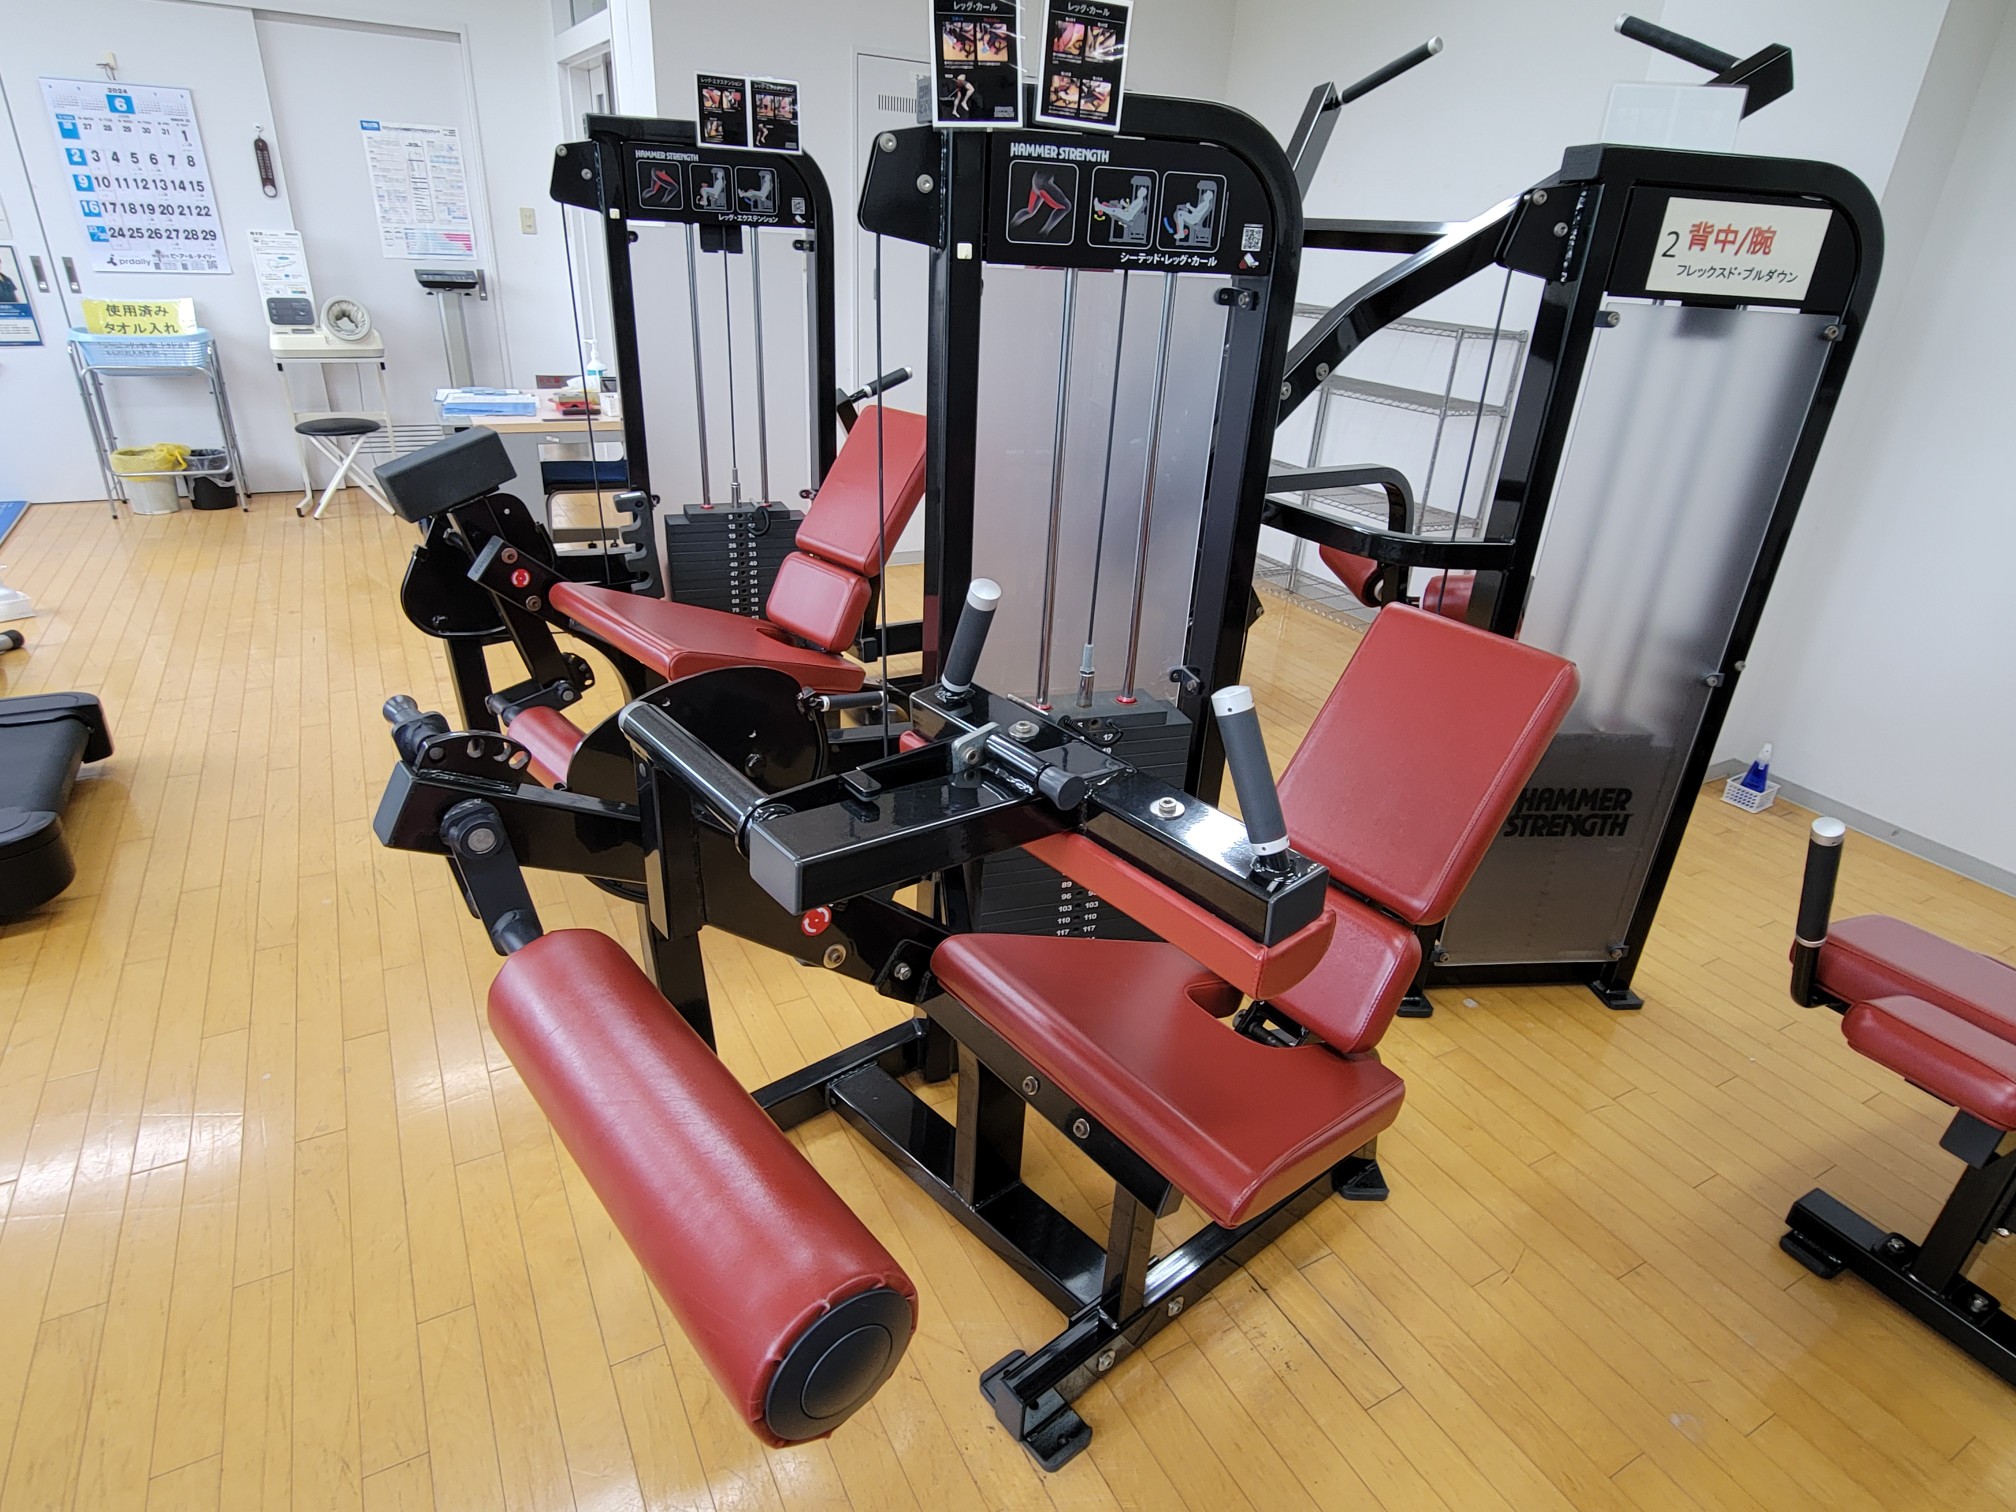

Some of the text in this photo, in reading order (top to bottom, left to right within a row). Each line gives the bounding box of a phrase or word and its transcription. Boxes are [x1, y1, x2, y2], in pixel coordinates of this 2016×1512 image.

[953, 0, 998, 12] レッグ・カール
[1068, 3, 1111, 17] レッグ・カール
[114, 97, 128, 111] 6
[83, 123, 92, 131] 27
[181, 130, 188, 142] 1
[71, 150, 196, 167] 2 3 4 5 6 7 8
[635, 150, 699, 162] HAMMER STRENGTH
[1010, 143, 1110, 163] HAMMER STRENGTH
[78, 175, 205, 192] 9 10 11 12 13 14 15
[81, 201, 212, 217] 16 17 18 19 20 21 22
[718, 214, 779, 223] レッグ・エクステンション
[108, 227, 126, 239] 24
[127, 228, 144, 239] 25
[146, 228, 162, 239] 26
[165, 229, 180, 240] 27
[183, 229, 199, 240] 28
[201, 230, 217, 241] 29
[1688, 221, 1777, 256] 背中/腕
[1661, 231, 1680, 258] 2
[1120, 252, 1218, 267] シーテッド・レッグ・カール
[106, 304, 169, 317] 使用済み
[104, 322, 178, 335] タオル入れ
[1517, 788, 1633, 813] HAMMER
[1503, 813, 1635, 837] STRENGTH
